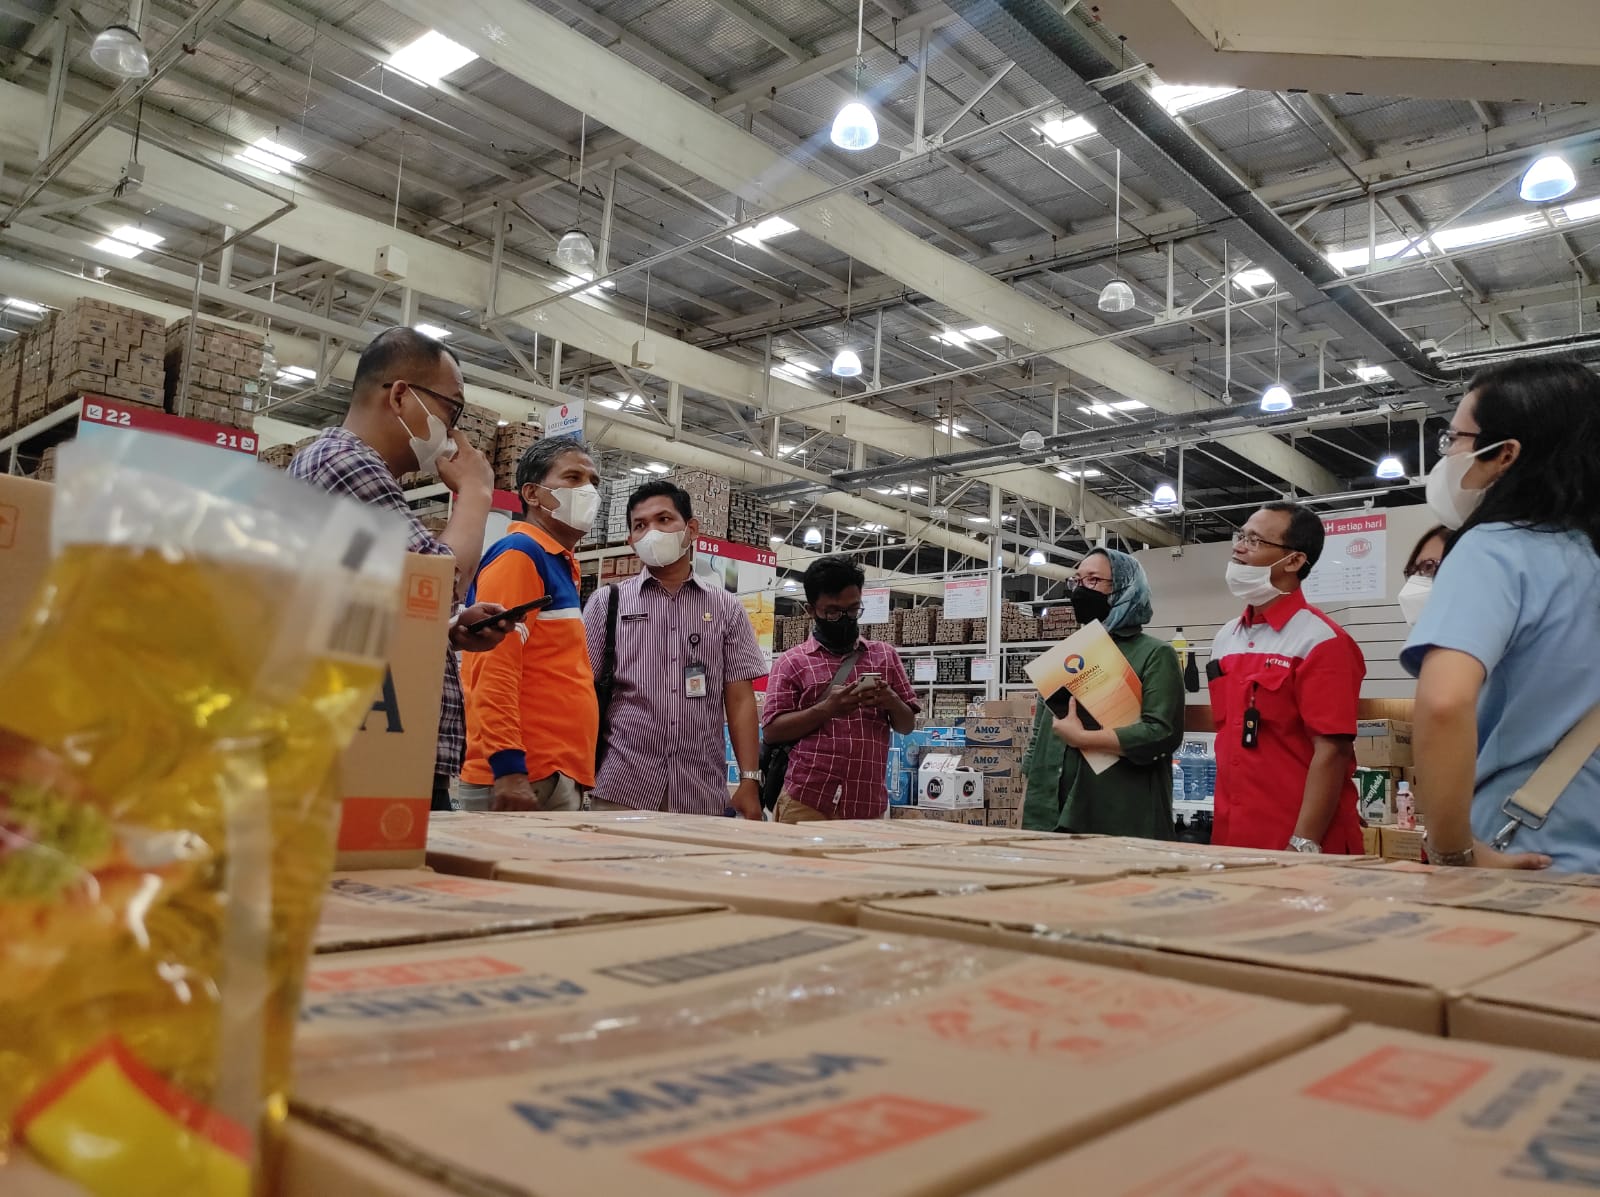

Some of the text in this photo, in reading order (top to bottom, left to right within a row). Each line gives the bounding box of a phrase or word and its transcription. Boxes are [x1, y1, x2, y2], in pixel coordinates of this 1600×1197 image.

[106, 408, 132, 426] 22
[215, 432, 238, 448] 21
[1337, 521, 1363, 532] setiap
[1365, 519, 1382, 529] hari
[707, 541, 719, 553] 18
[756, 552, 767, 564] 17
[417, 578, 434, 597] 6
[974, 725, 1001, 734] AMOZ
[973, 755, 999, 765] AMOZ
[507, 1052, 888, 1133] AMANDA
